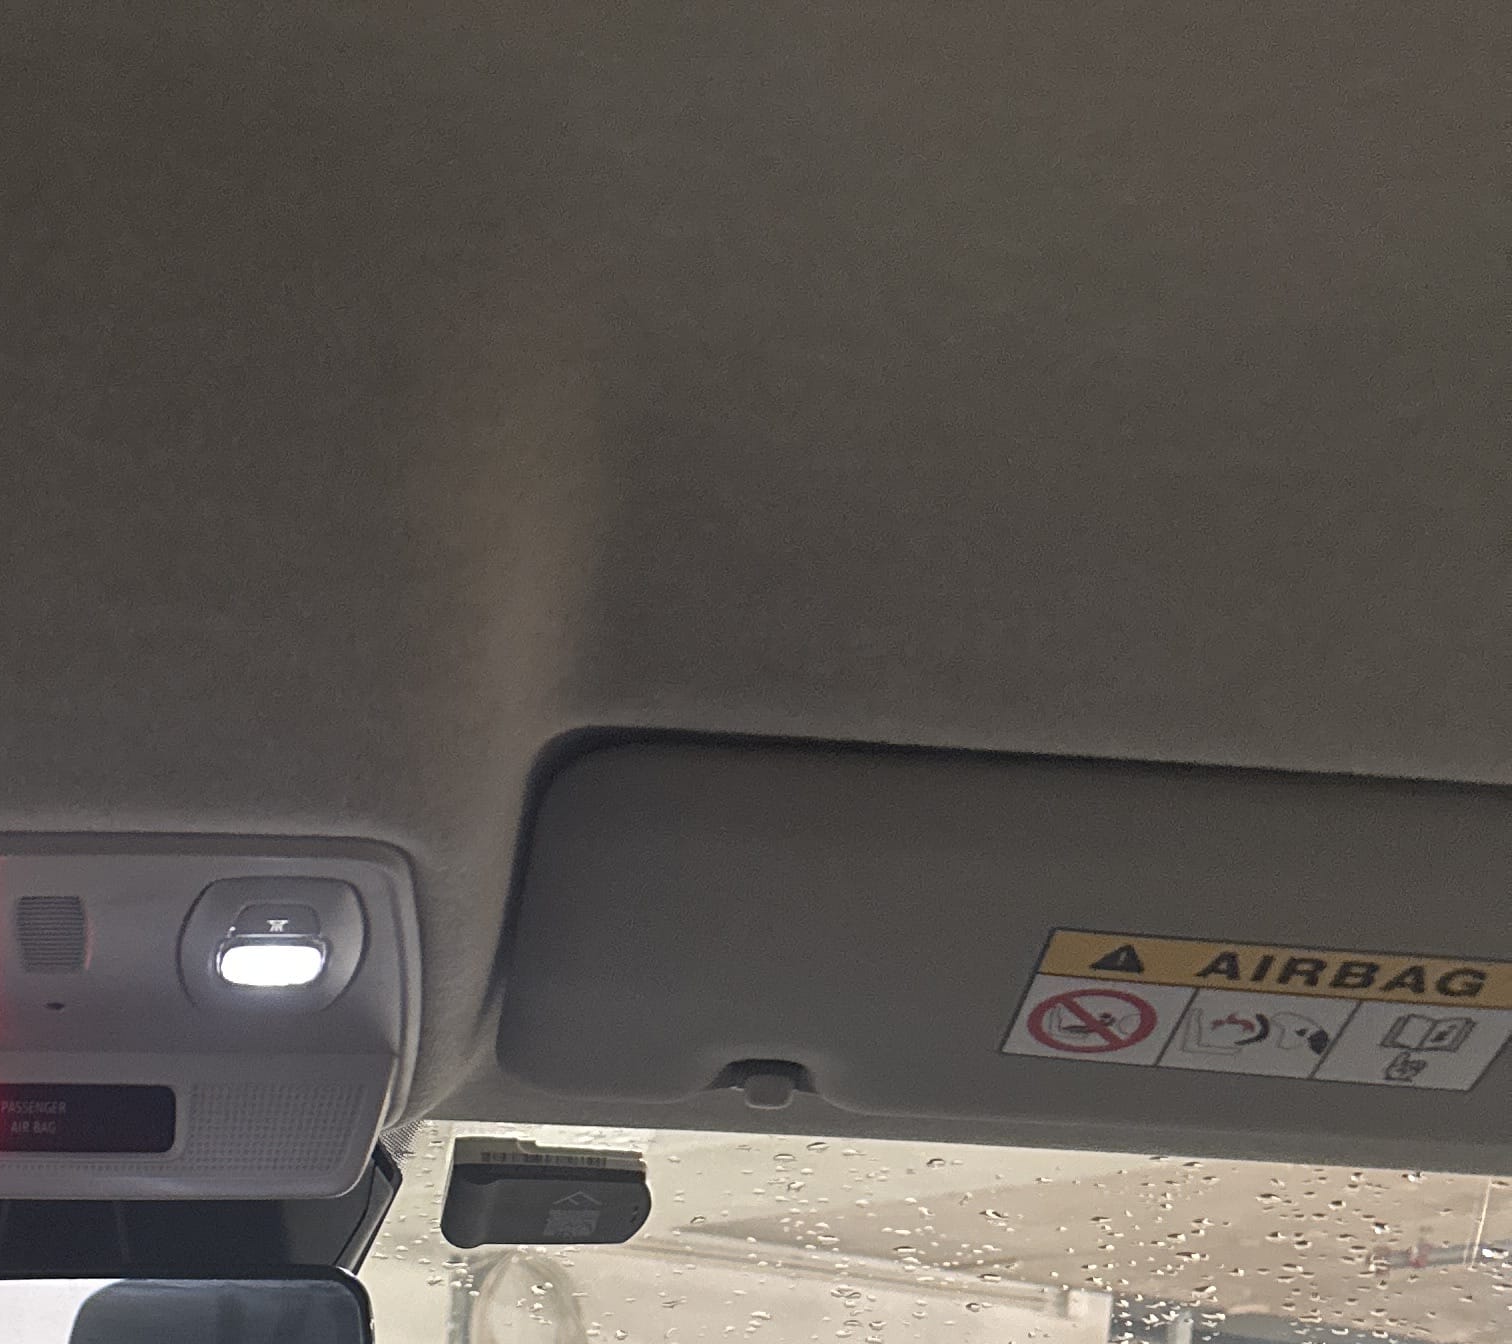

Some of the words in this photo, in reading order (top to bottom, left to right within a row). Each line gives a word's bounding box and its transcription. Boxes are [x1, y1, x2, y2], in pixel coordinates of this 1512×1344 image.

[1196, 951, 1487, 998] AIRBAG
[0, 1101, 67, 1114] PASSENGER
[11, 1121, 30, 1133] AIR
[33, 1121, 57, 1134] BAG
